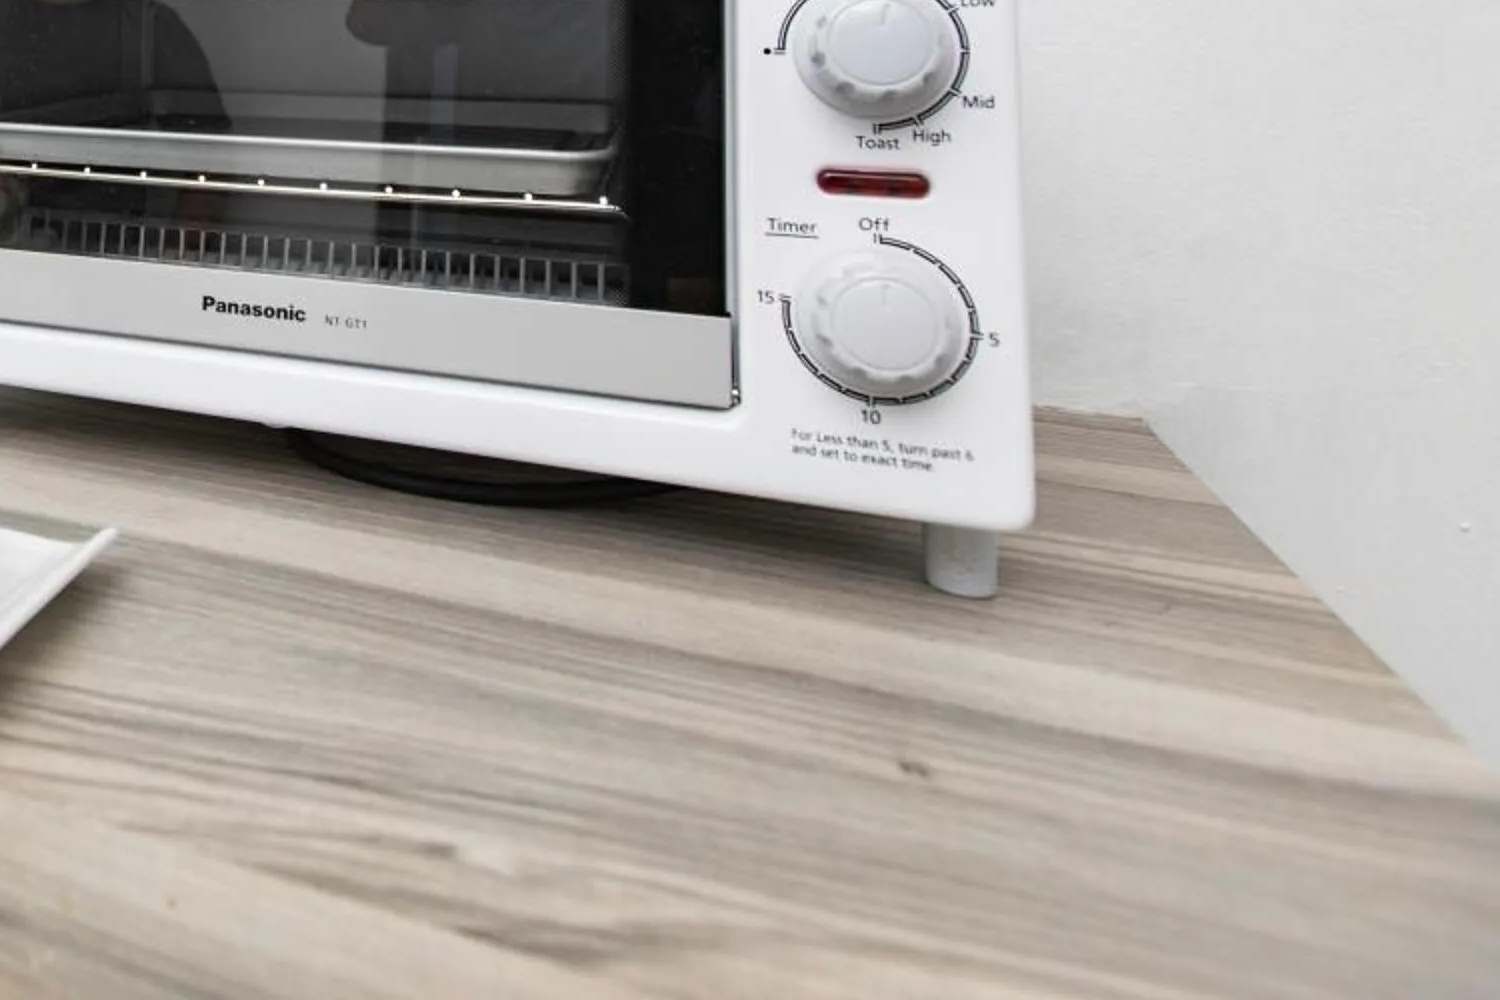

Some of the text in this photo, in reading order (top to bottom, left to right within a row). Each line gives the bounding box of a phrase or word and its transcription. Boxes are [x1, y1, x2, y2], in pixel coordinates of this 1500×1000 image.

[963, 96, 996, 109] Mid
[856, 136, 900, 150] Toast
[912, 130, 951, 146] High
[768, 218, 818, 233] Timer
[859, 217, 891, 231] Off
[757, 290, 775, 304] 15
[202, 296, 306, 322] Panasonic
[989, 333, 1000, 346] 5
[861, 410, 881, 424] 10
[791, 427, 812, 442] For
[816, 431, 844, 446] Less
[846, 435, 878, 450] than
[792, 445, 817, 457] and
[820, 446, 840, 459] set
[843, 450, 858, 462] to
[861, 453, 898, 468] exact
